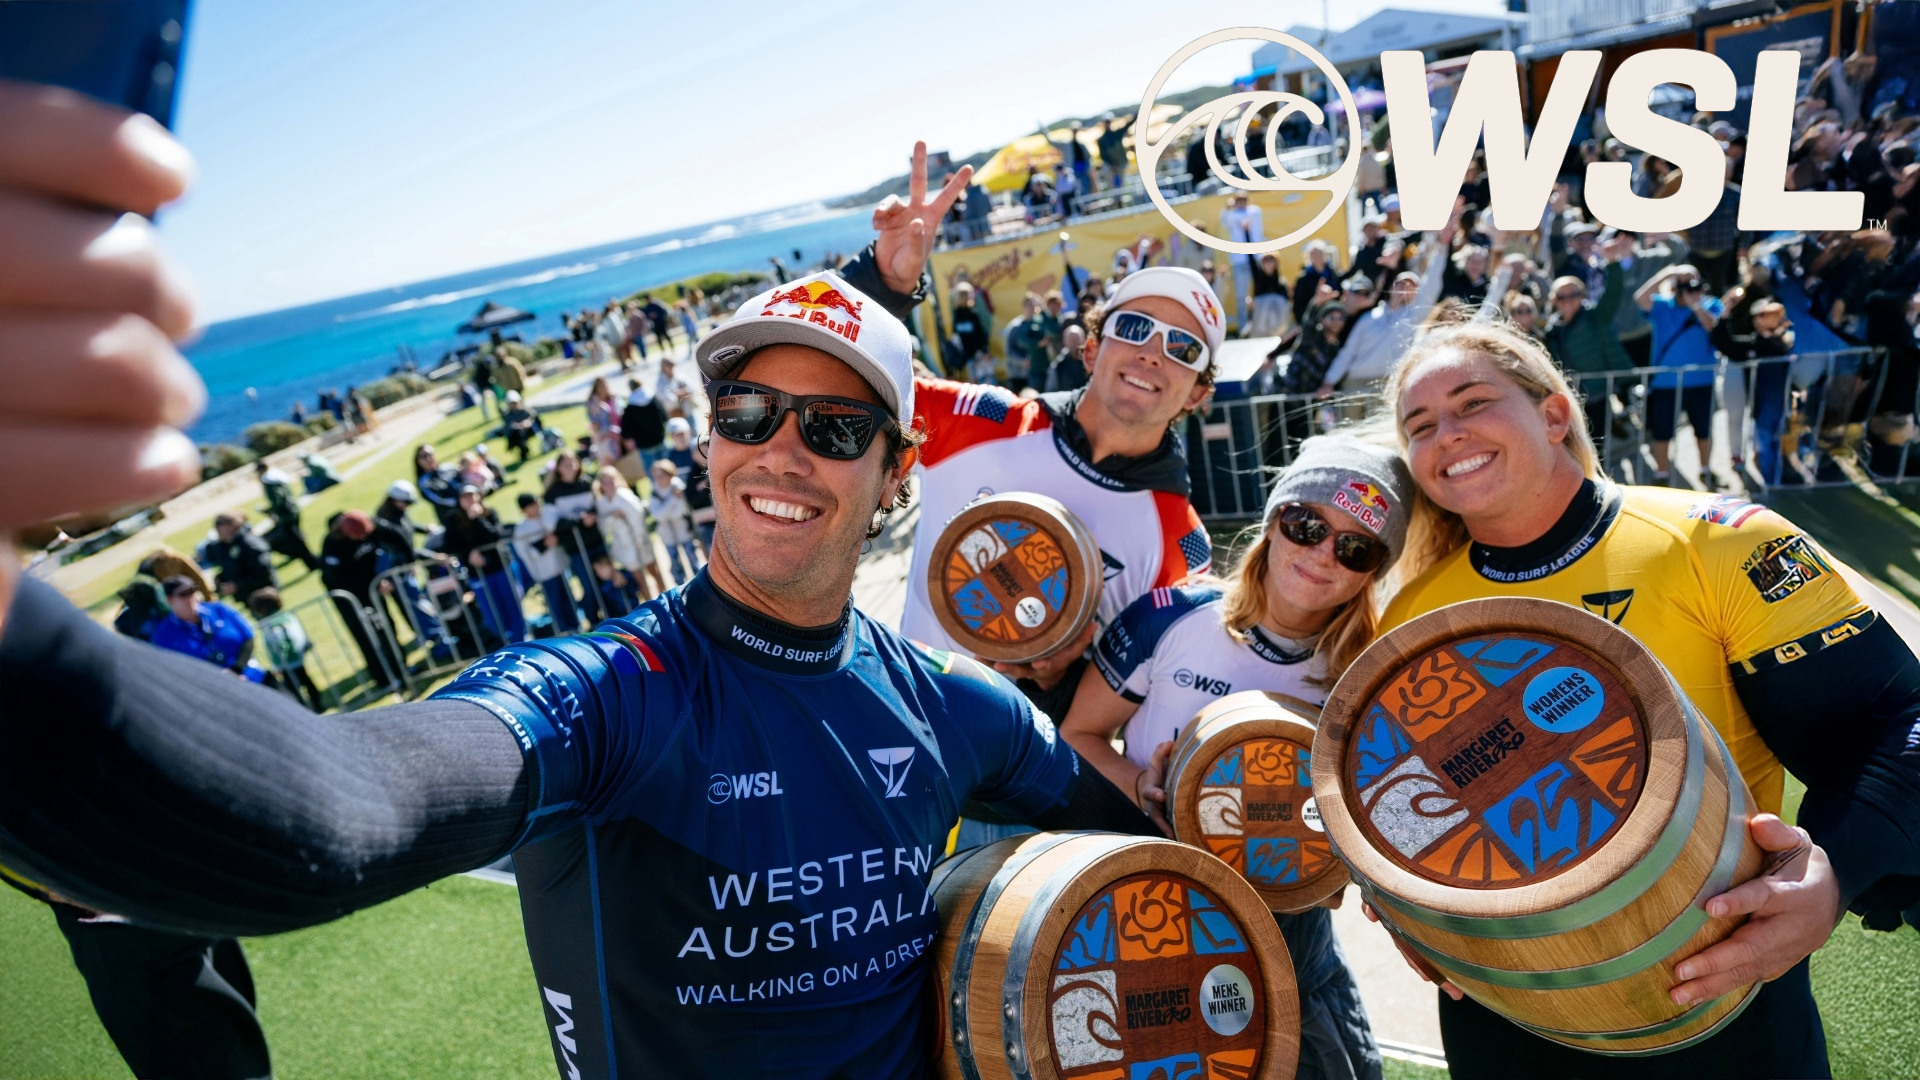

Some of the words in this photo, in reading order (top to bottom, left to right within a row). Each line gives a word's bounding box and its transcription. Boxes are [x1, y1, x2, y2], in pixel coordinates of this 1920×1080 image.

[1333, 491, 1361, 515] Red
[1360, 507, 1385, 533] Bull
[1480, 564, 1515, 582] WORLD
[1516, 566, 1549, 582] SURF
[1550, 534, 1595, 572] LEAGUE
[731, 624, 784, 657] WORLD
[784, 648, 824, 663] SURF
[1527, 672, 1586, 715] WOMENS
[1541, 684, 1596, 725] WINNER
[496, 705, 532, 751] TOUR
[1440, 717, 1516, 778] MARGARET
[732, 770, 783, 799] WSL
[1247, 803, 1293, 813] MARGARET
[708, 844, 933, 910] WESTERN
[676, 972, 814, 1006] WALKING
[823, 963, 858, 987] ON
[865, 957, 881, 977] A
[1125, 988, 1190, 1012] MARGARET
[1212, 982, 1240, 1000] MENS
[1208, 997, 1247, 1016] WINNER
